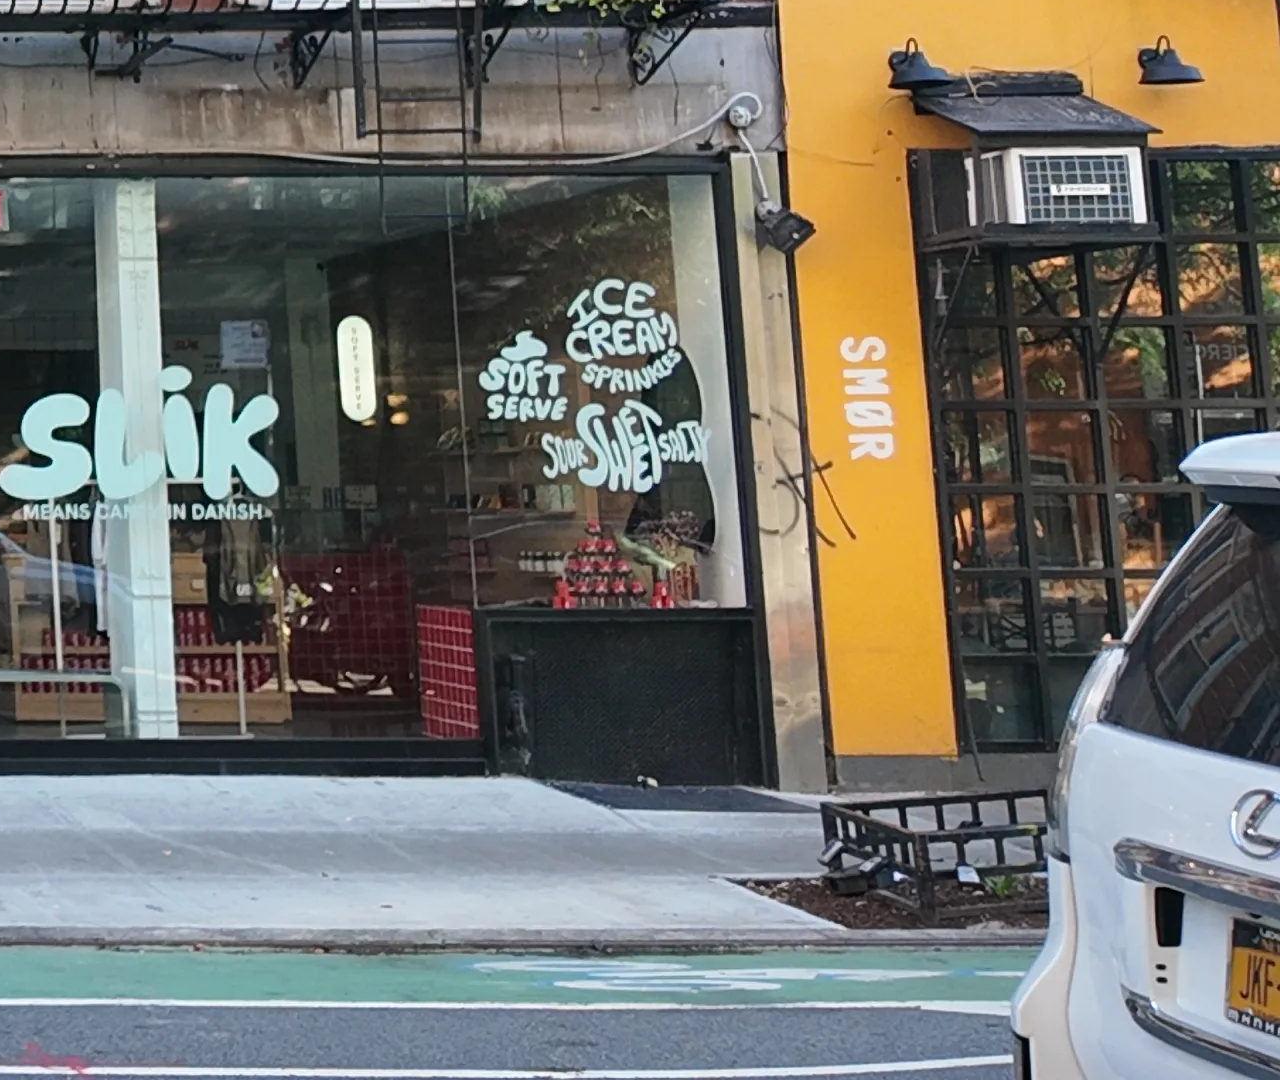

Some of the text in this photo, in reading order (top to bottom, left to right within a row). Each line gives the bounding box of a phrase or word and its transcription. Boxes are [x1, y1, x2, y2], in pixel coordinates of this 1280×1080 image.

[566, 279, 656, 330] ICE
[565, 311, 678, 363] CREAM
[478, 357, 566, 397] SOFT
[581, 348, 682, 393] SPRINKLES
[487, 394, 568, 422] SERVE
[840, 336, 894, 460] SMØR
[541, 399, 712, 493] SOUR SWEET SALTY
[23, 503, 90, 520] MEANS
[167, 503, 186, 520] IN
[192, 503, 263, 520] DANISH
